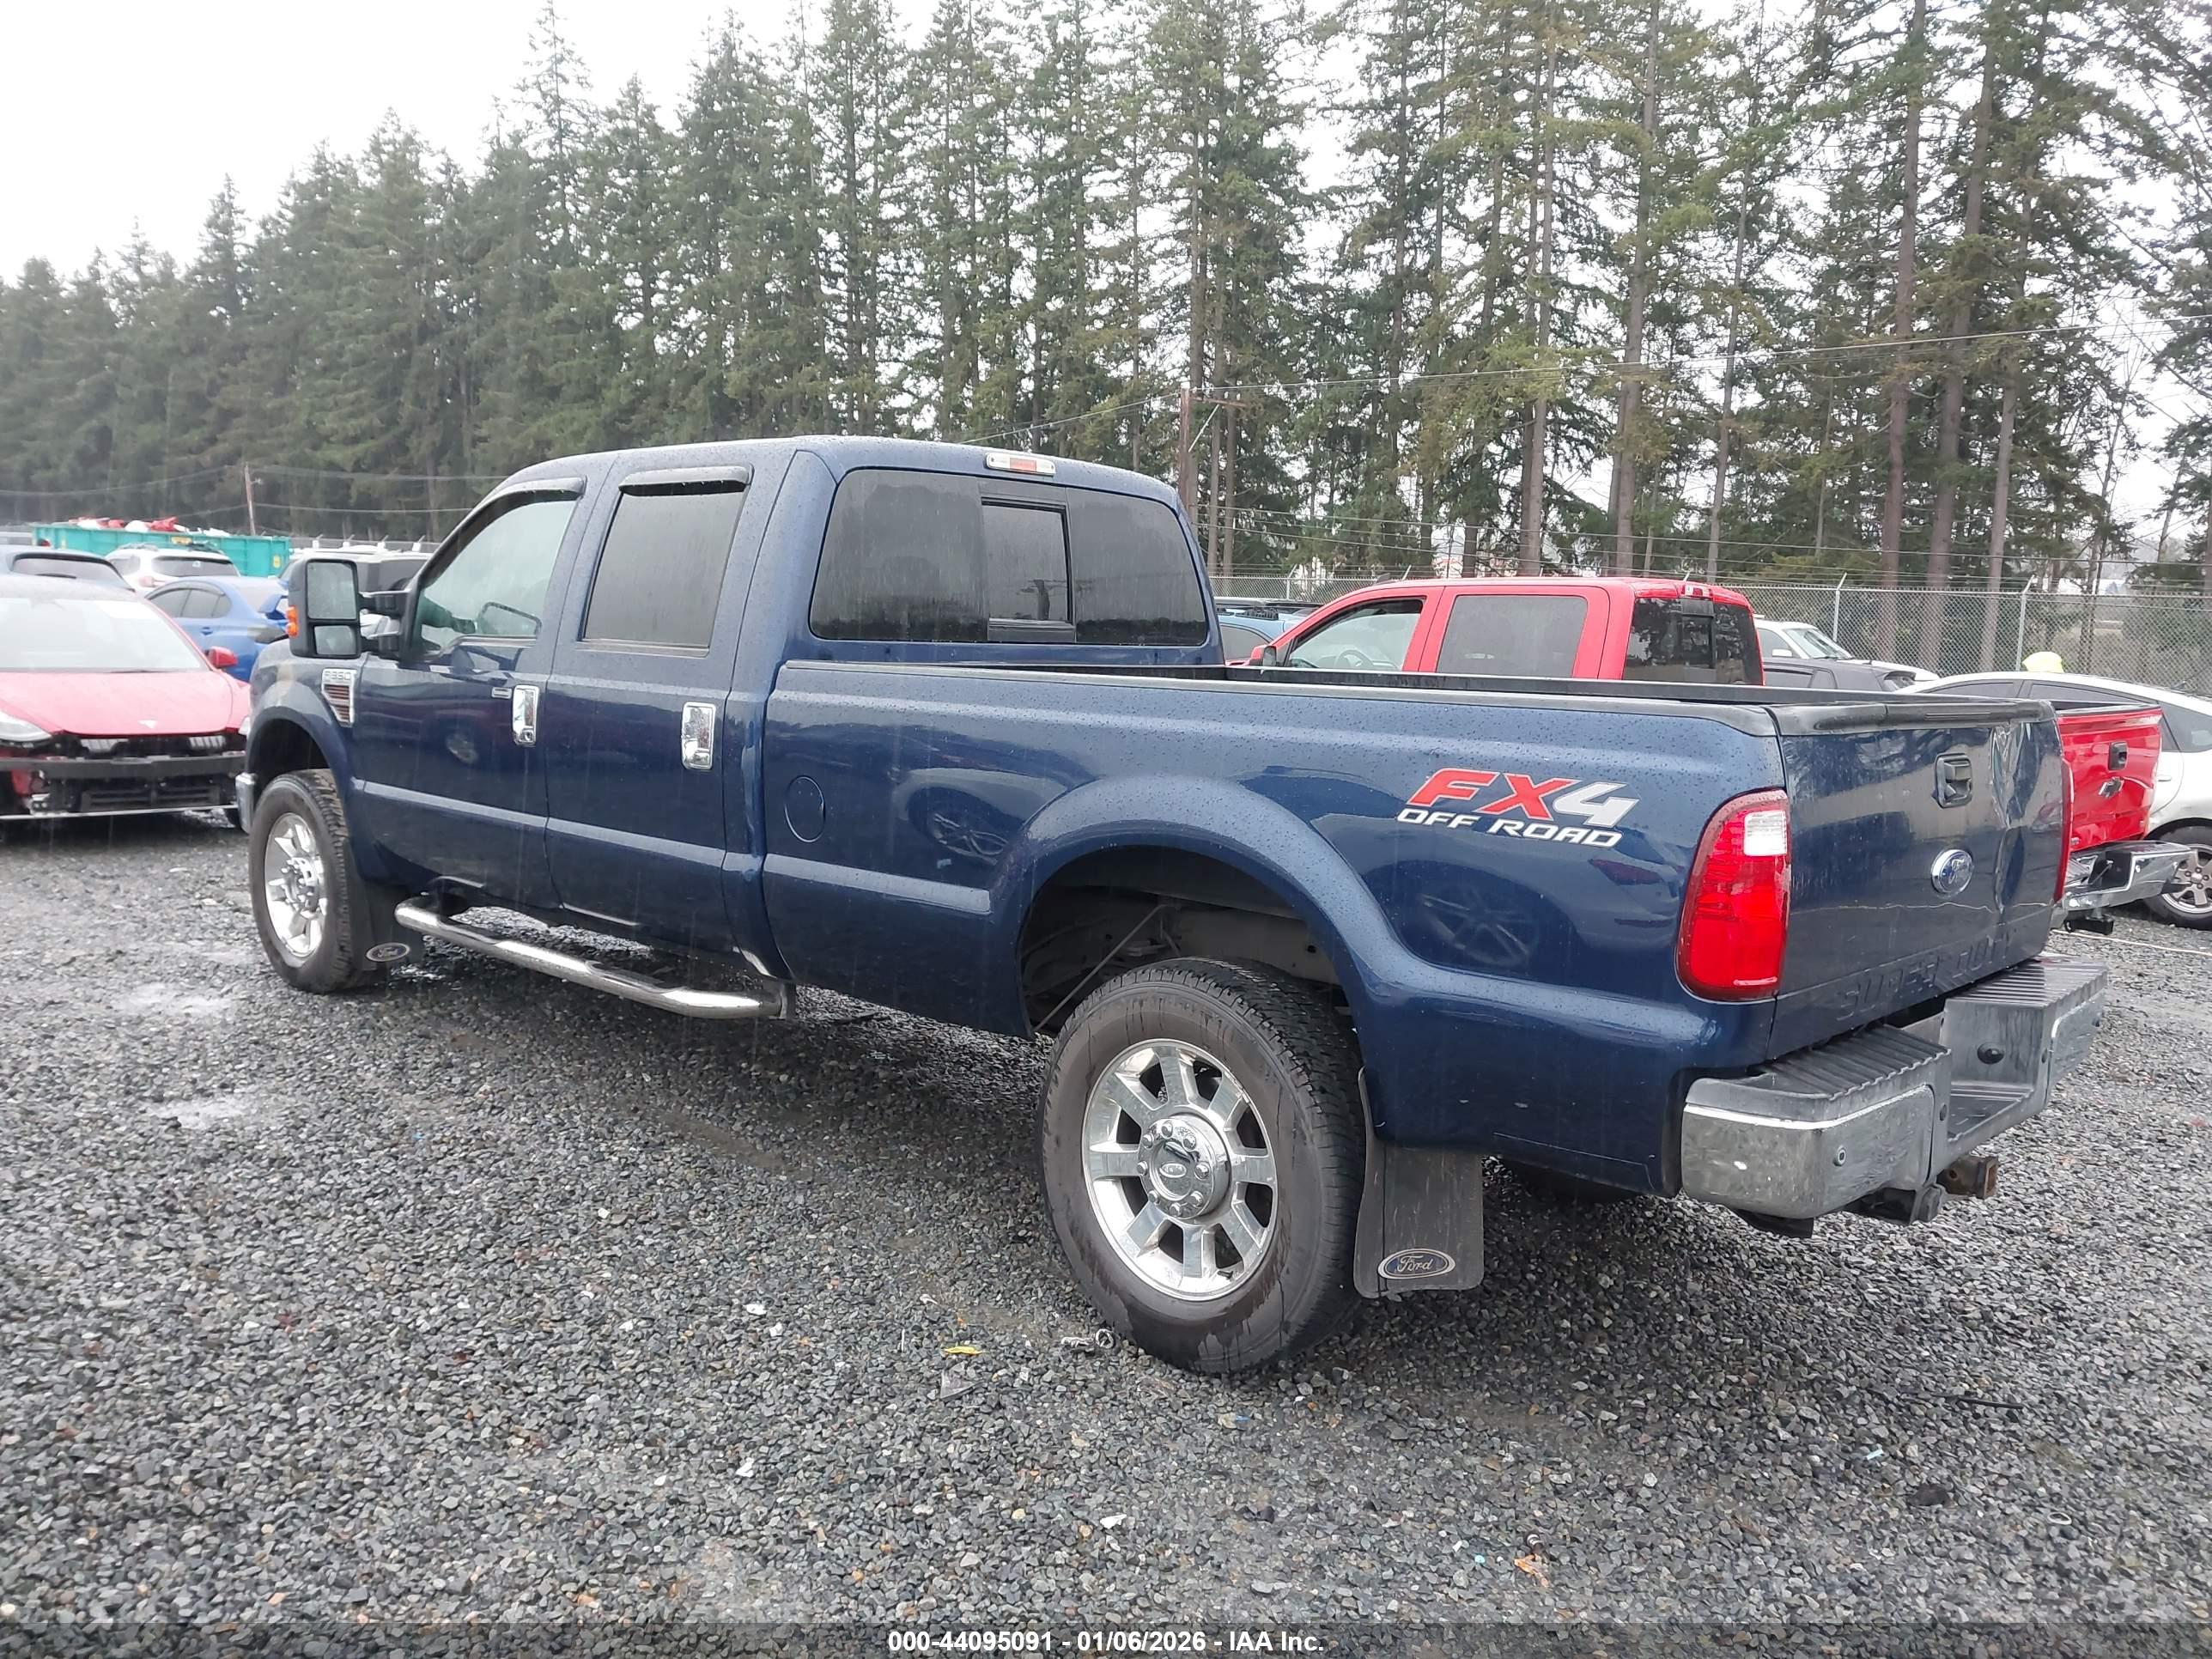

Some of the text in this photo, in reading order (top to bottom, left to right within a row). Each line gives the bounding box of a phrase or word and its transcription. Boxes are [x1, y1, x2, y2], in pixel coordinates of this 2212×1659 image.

[1406, 768, 1640, 829] FX4
[1396, 808, 1625, 848] OFF ROAD
[1397, 1255, 1434, 1272] Ford
